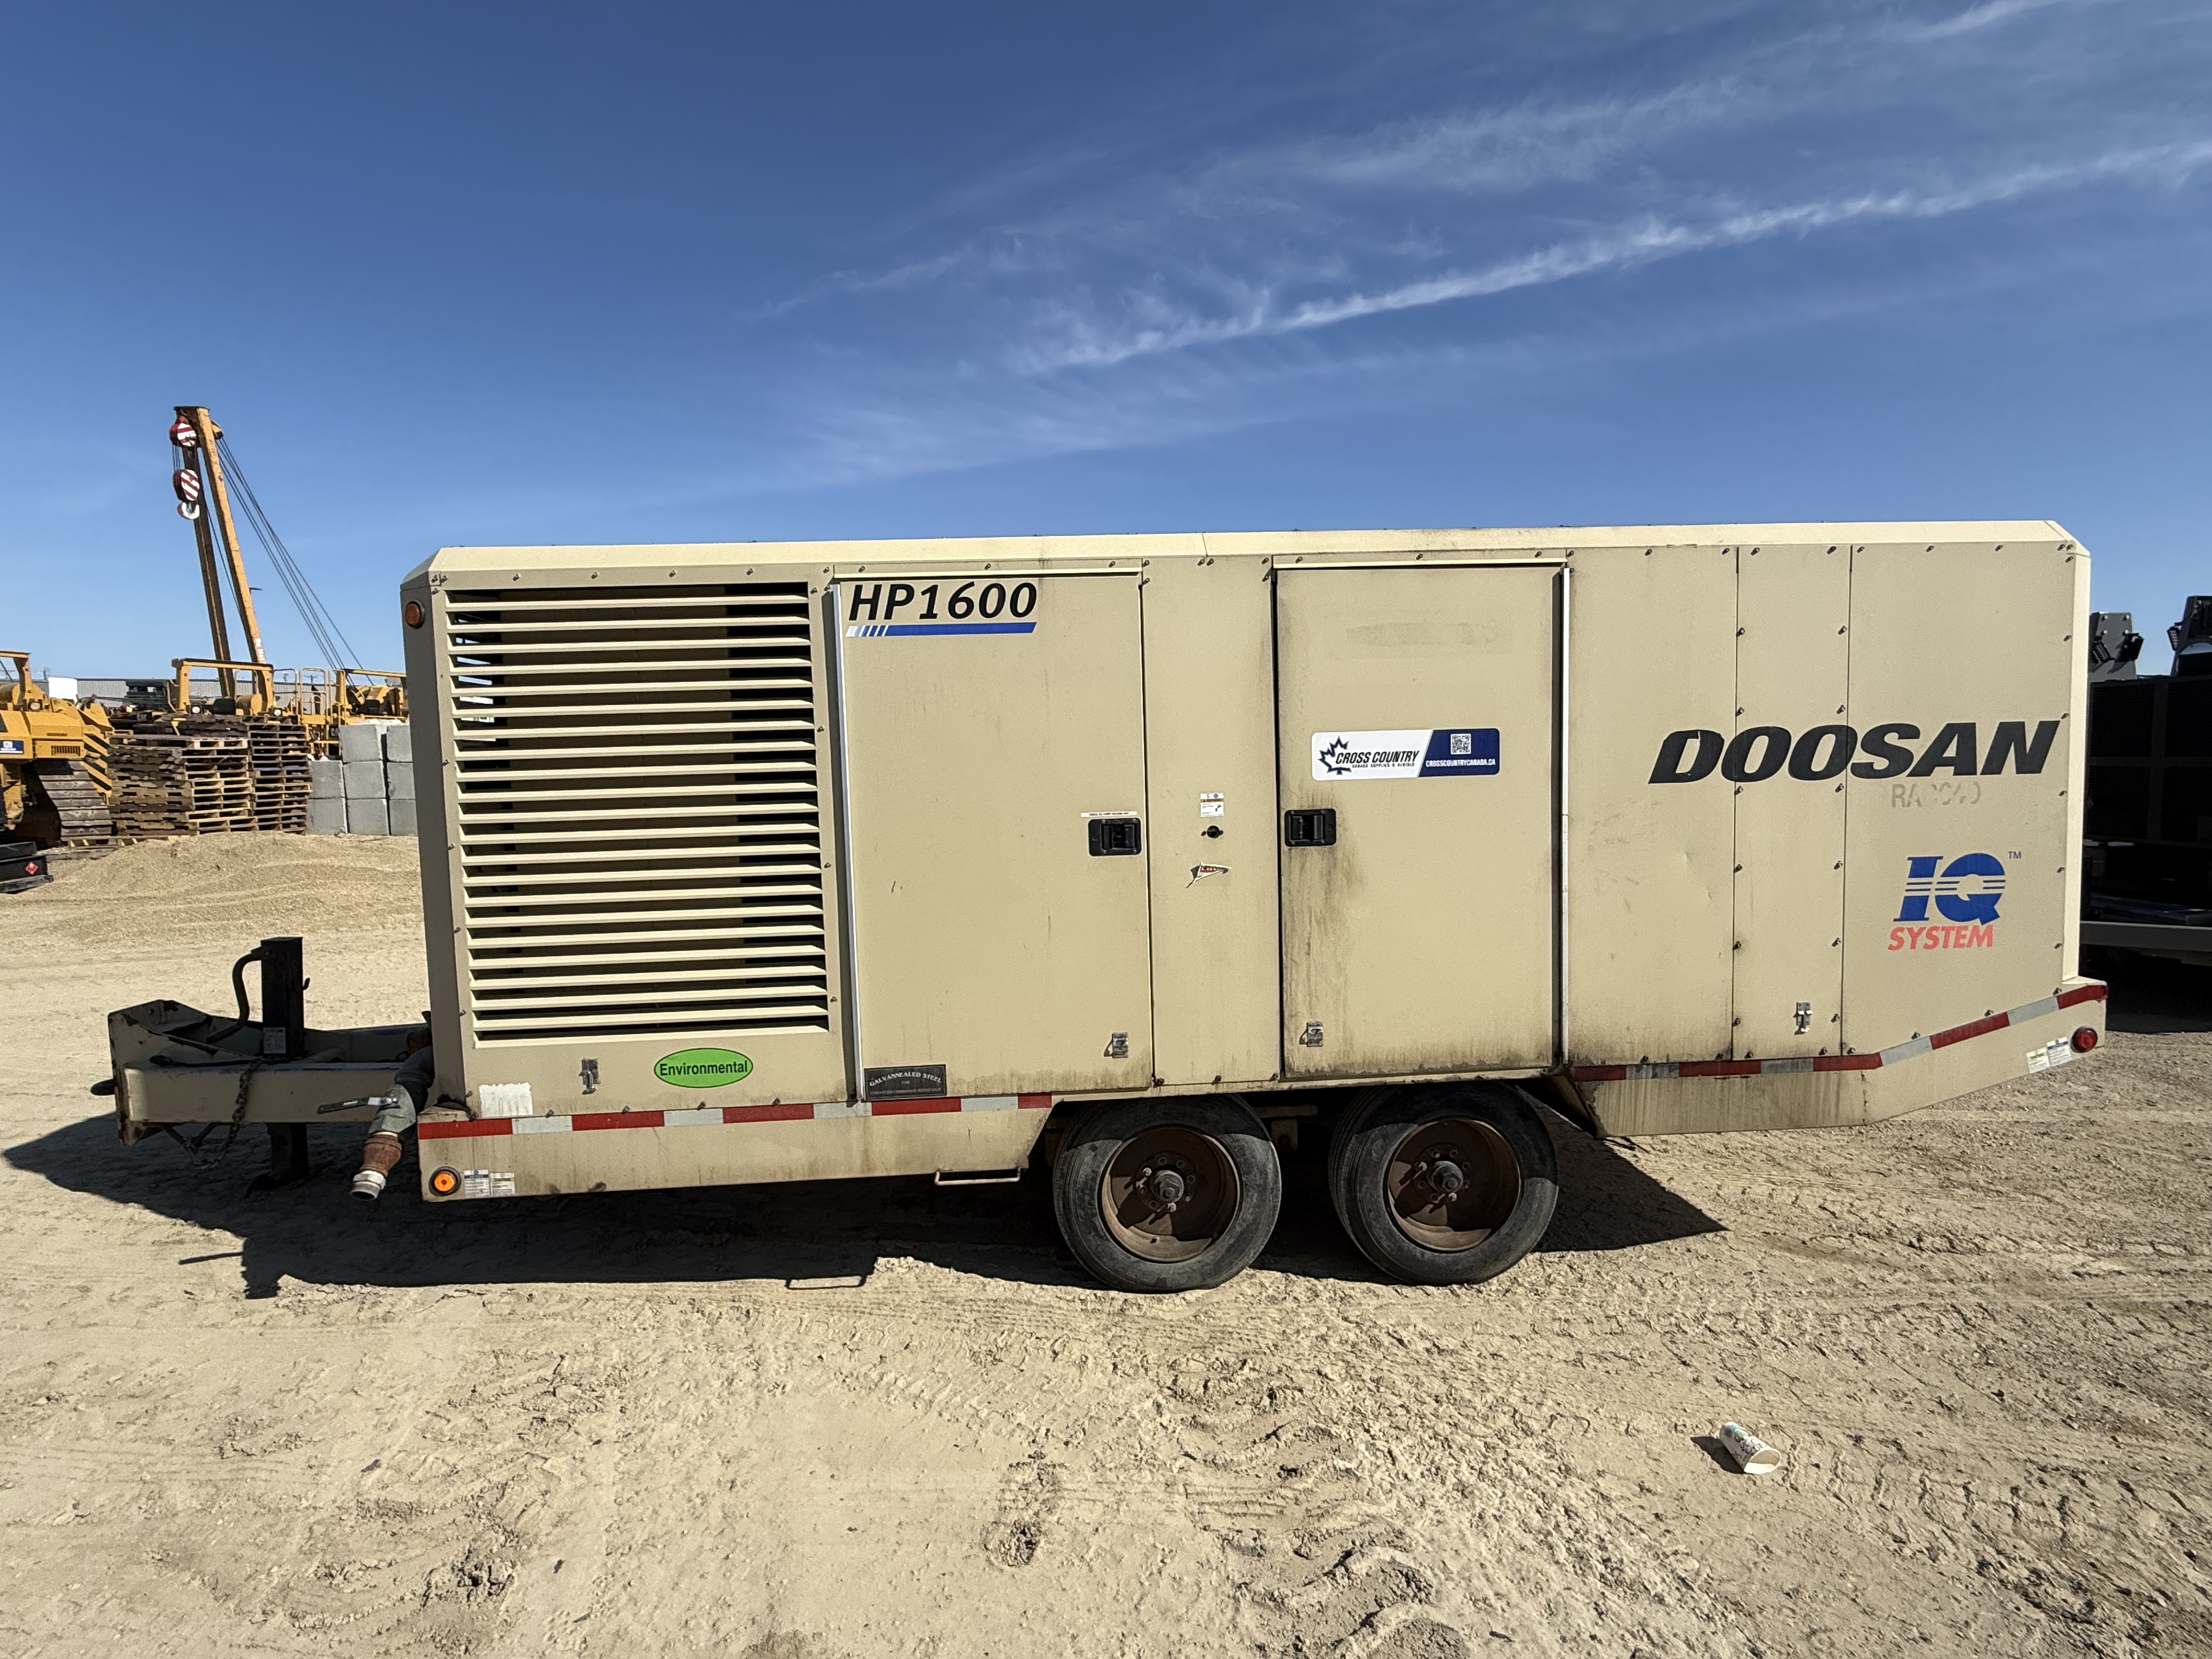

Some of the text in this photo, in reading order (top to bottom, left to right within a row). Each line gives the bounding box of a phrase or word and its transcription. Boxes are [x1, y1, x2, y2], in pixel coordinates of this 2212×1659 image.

[849, 581, 1037, 620] HP1600
[1335, 750, 1420, 764] CROSS COUNTRY
[1648, 720, 2061, 784] DOOSAN
[1893, 853, 2006, 926] IQ
[1888, 924, 1994, 951] SYSTEM
[660, 1060, 747, 1076] Environmental
[923, 1073, 941, 1083] STEEL
